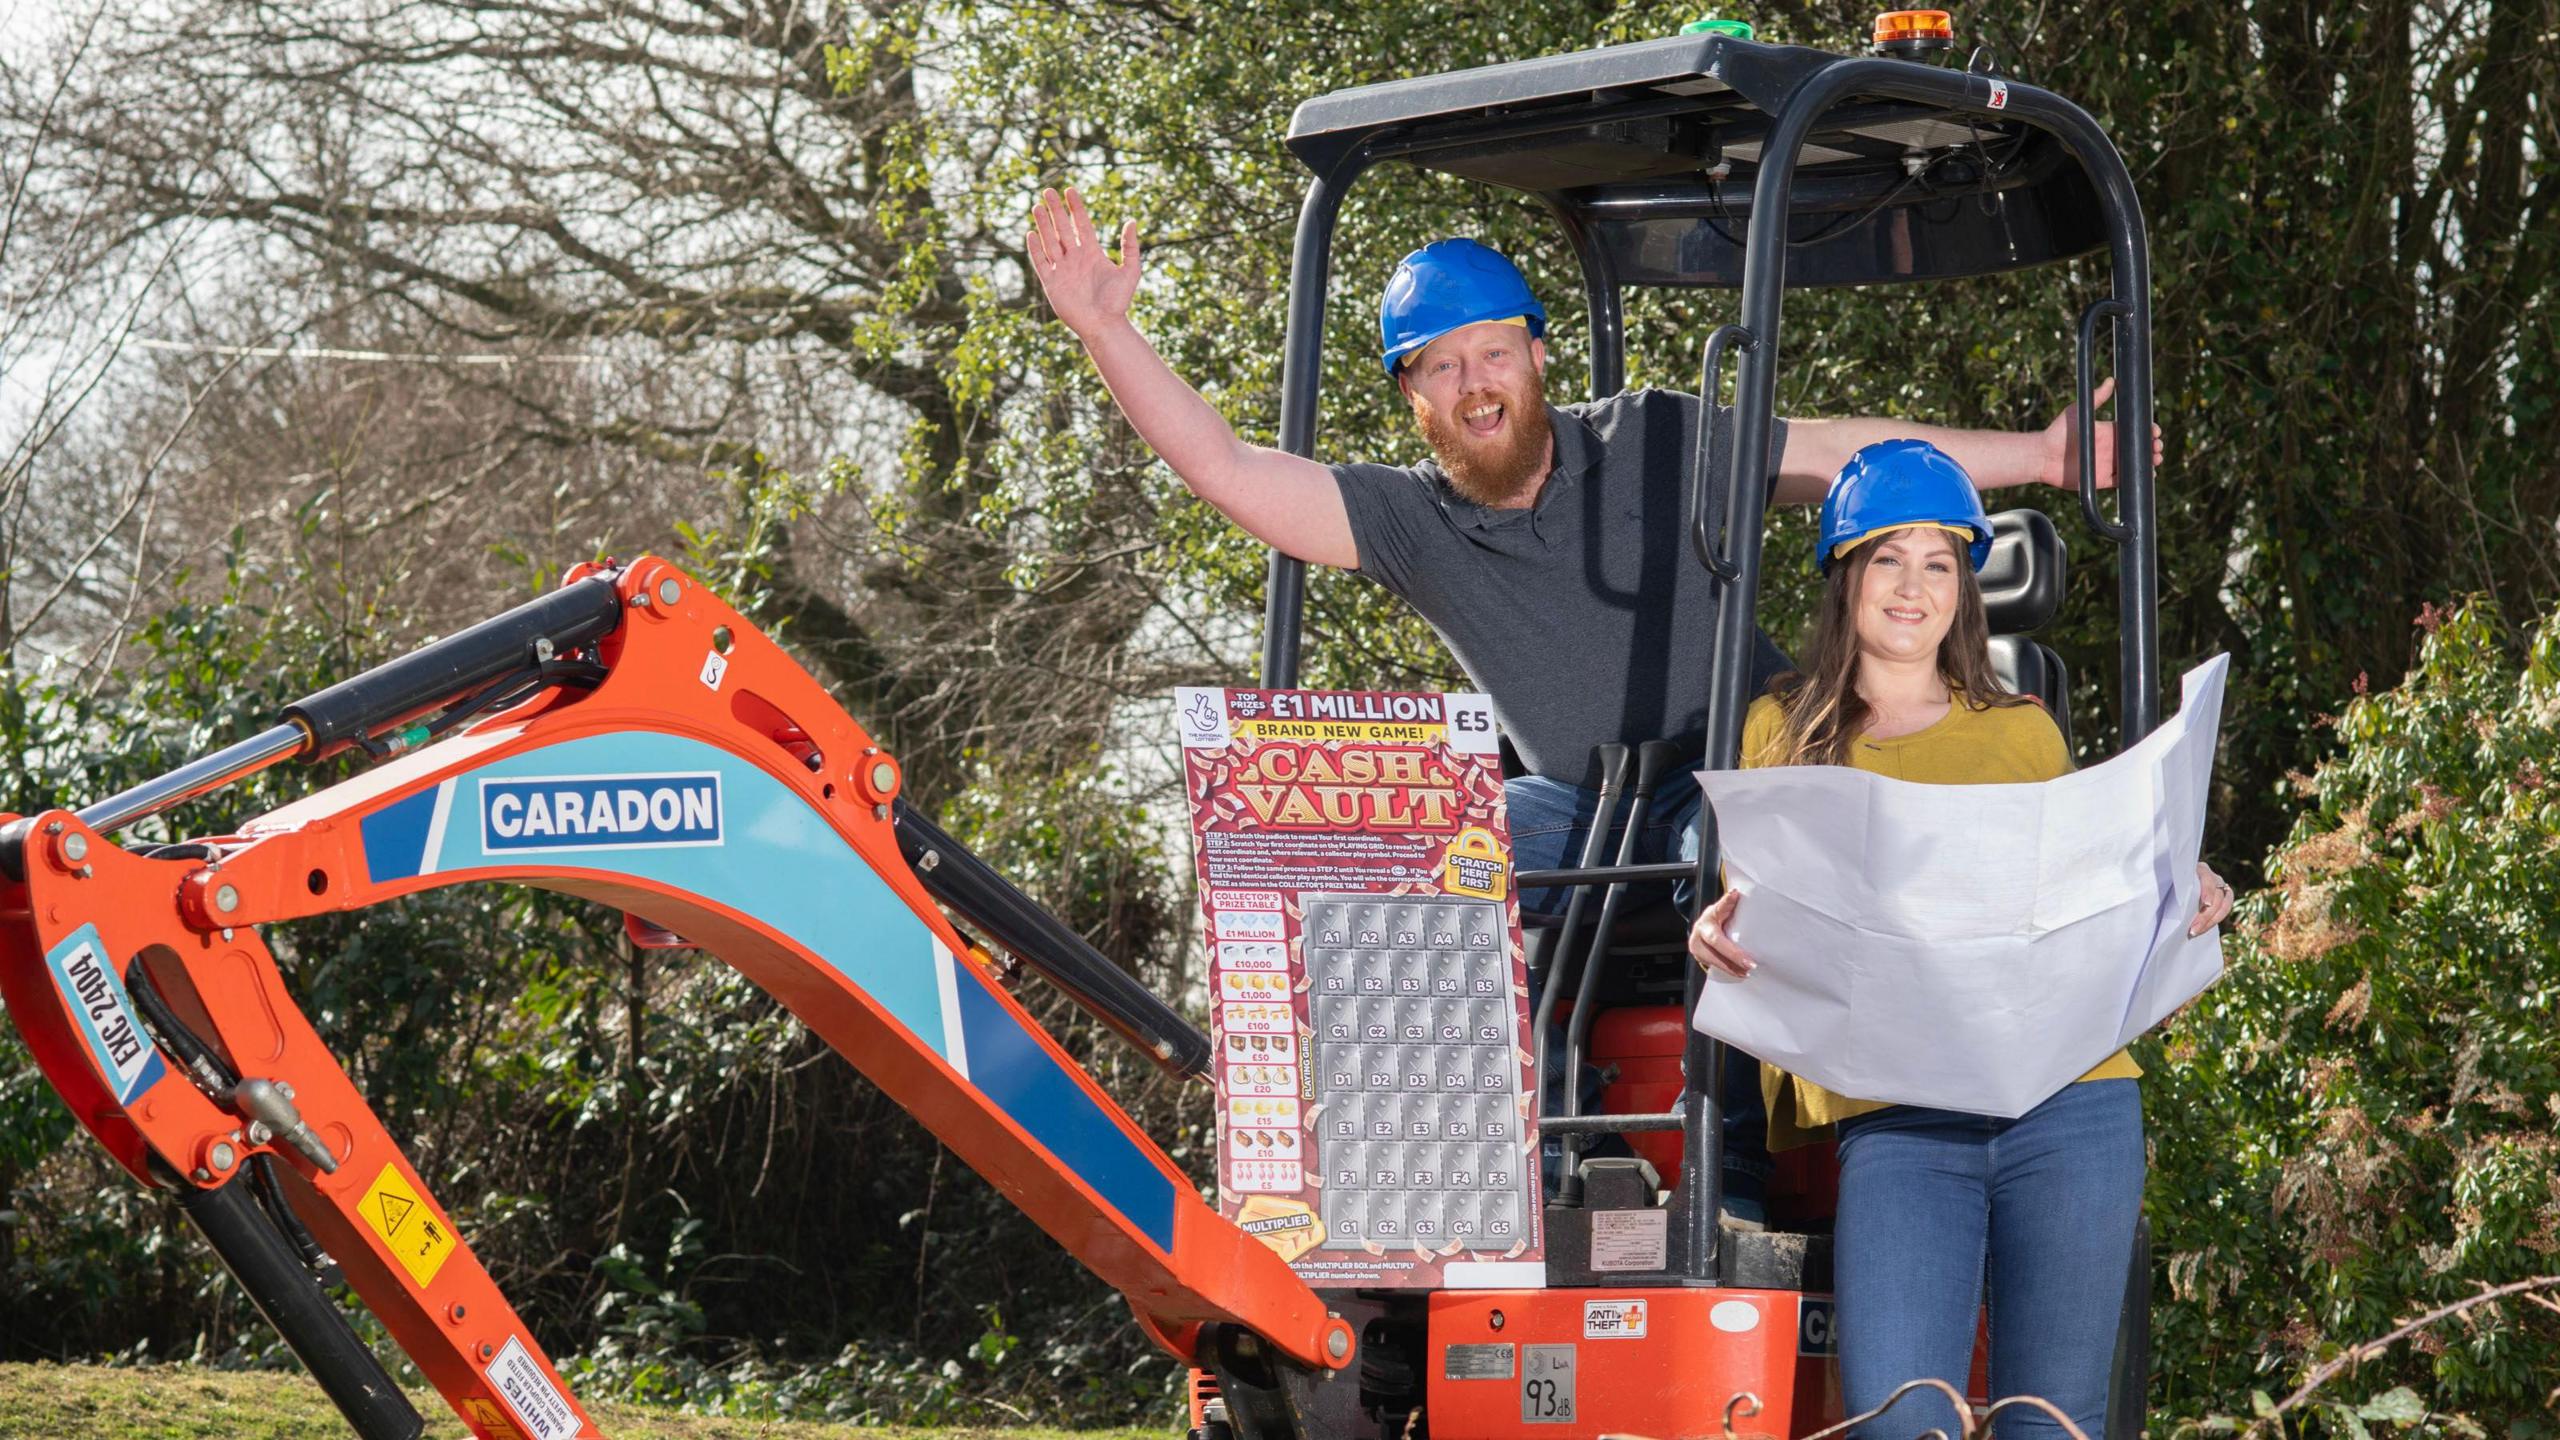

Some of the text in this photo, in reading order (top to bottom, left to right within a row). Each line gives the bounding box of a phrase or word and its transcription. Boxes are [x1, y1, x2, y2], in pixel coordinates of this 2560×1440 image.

[1230, 701, 1265, 709] PRIZES
[1271, 694, 1441, 721] £1 MILLION
[1455, 711, 1489, 732] £5
[1257, 724, 1424, 739] BRAND NEW GAME!
[1259, 749, 1426, 785] CASH
[491, 788, 713, 838] CARADON
[1236, 785, 1456, 827] VAULT
[1266, 833, 1290, 841] padlock
[1450, 854, 1503, 872] SCRATCH
[1461, 867, 1491, 880] HERE
[1459, 876, 1492, 890] FIRST
[1215, 893, 1278, 901] COLLECTOR'S
[1324, 933, 1489, 945] A1 A2 A3 A4 A5
[1235, 961, 1272, 969] £10,000
[1328, 979, 1493, 992] B1 B2 B3 B4 B5
[67, 952, 141, 1068] EXC 2404
[1332, 1027, 1497, 1039] C1 C2 C3 C4 C5
[1303, 1059, 1312, 1097] PLAYING
[1336, 1075, 1501, 1087] D1 D2 D3 D4 D5
[1338, 1123, 1503, 1135] E1 E2 E3 E4 E5
[1339, 1173, 1506, 1184] F1 F2 F3 F4 F5
[1242, 1215, 1310, 1232] MULTIPLIER
[1341, 1223, 1509, 1233] G1 G2 G3 G4 G5
[1588, 1311, 1614, 1319] ANTI
[1587, 1321, 1621, 1329] THEFT
[517, 1356, 567, 1419] SAFETY PIN REQUIRED
[507, 1360, 564, 1433] MANUAL COUPLER FITTED
[1527, 1379, 1570, 1416] 93 dB
[503, 1377, 550, 1438] WHITES
